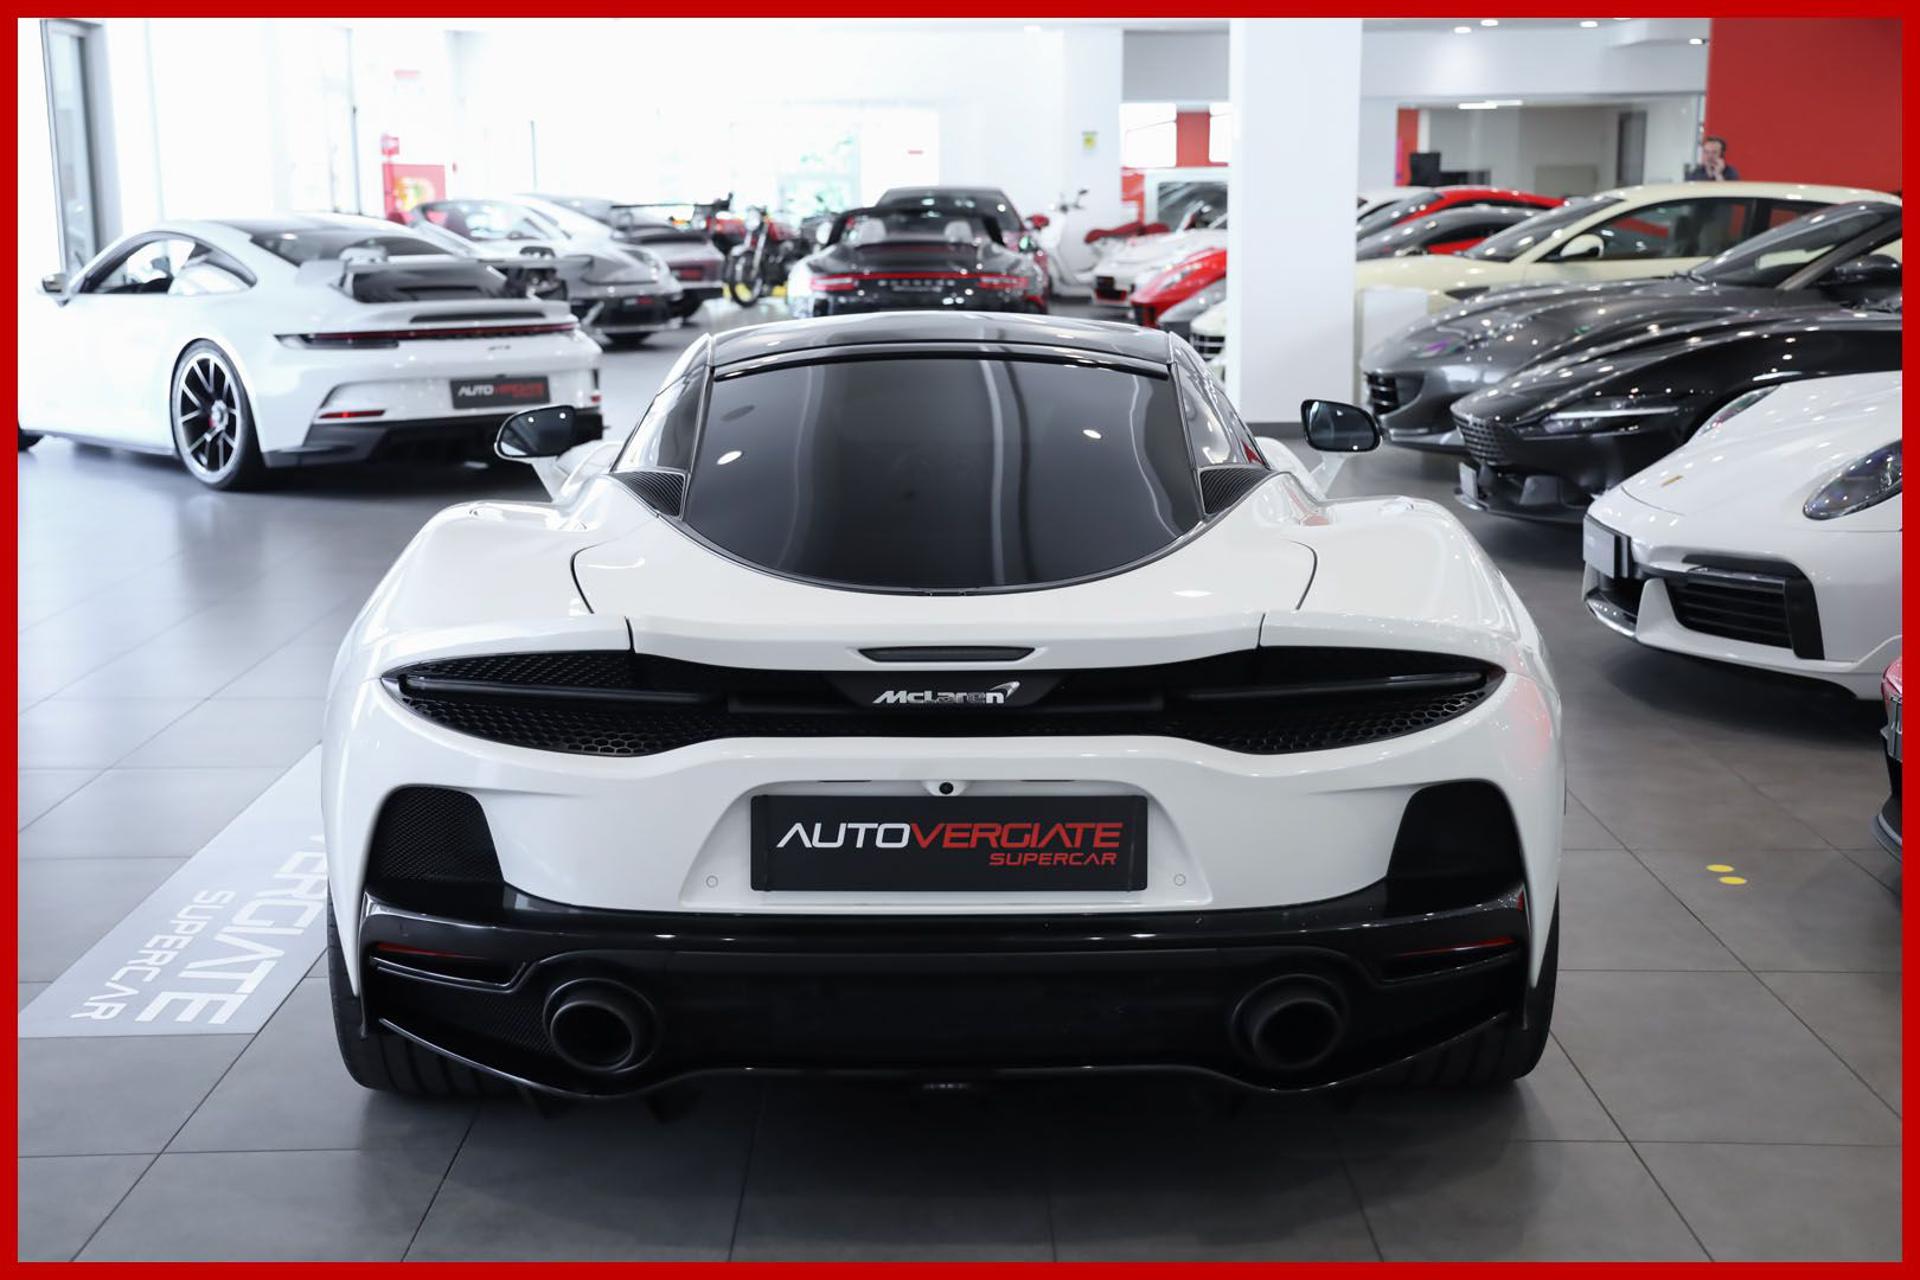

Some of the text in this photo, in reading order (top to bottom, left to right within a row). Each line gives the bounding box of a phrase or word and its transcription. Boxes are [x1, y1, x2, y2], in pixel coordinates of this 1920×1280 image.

[872, 689, 1005, 704] McLaren
[776, 822, 1123, 848] AUTOVERGIATE
[989, 852, 1117, 866] SUPERCAR
[134, 832, 328, 1025] ERGIATE
[70, 889, 237, 1021] SUPERCAR
